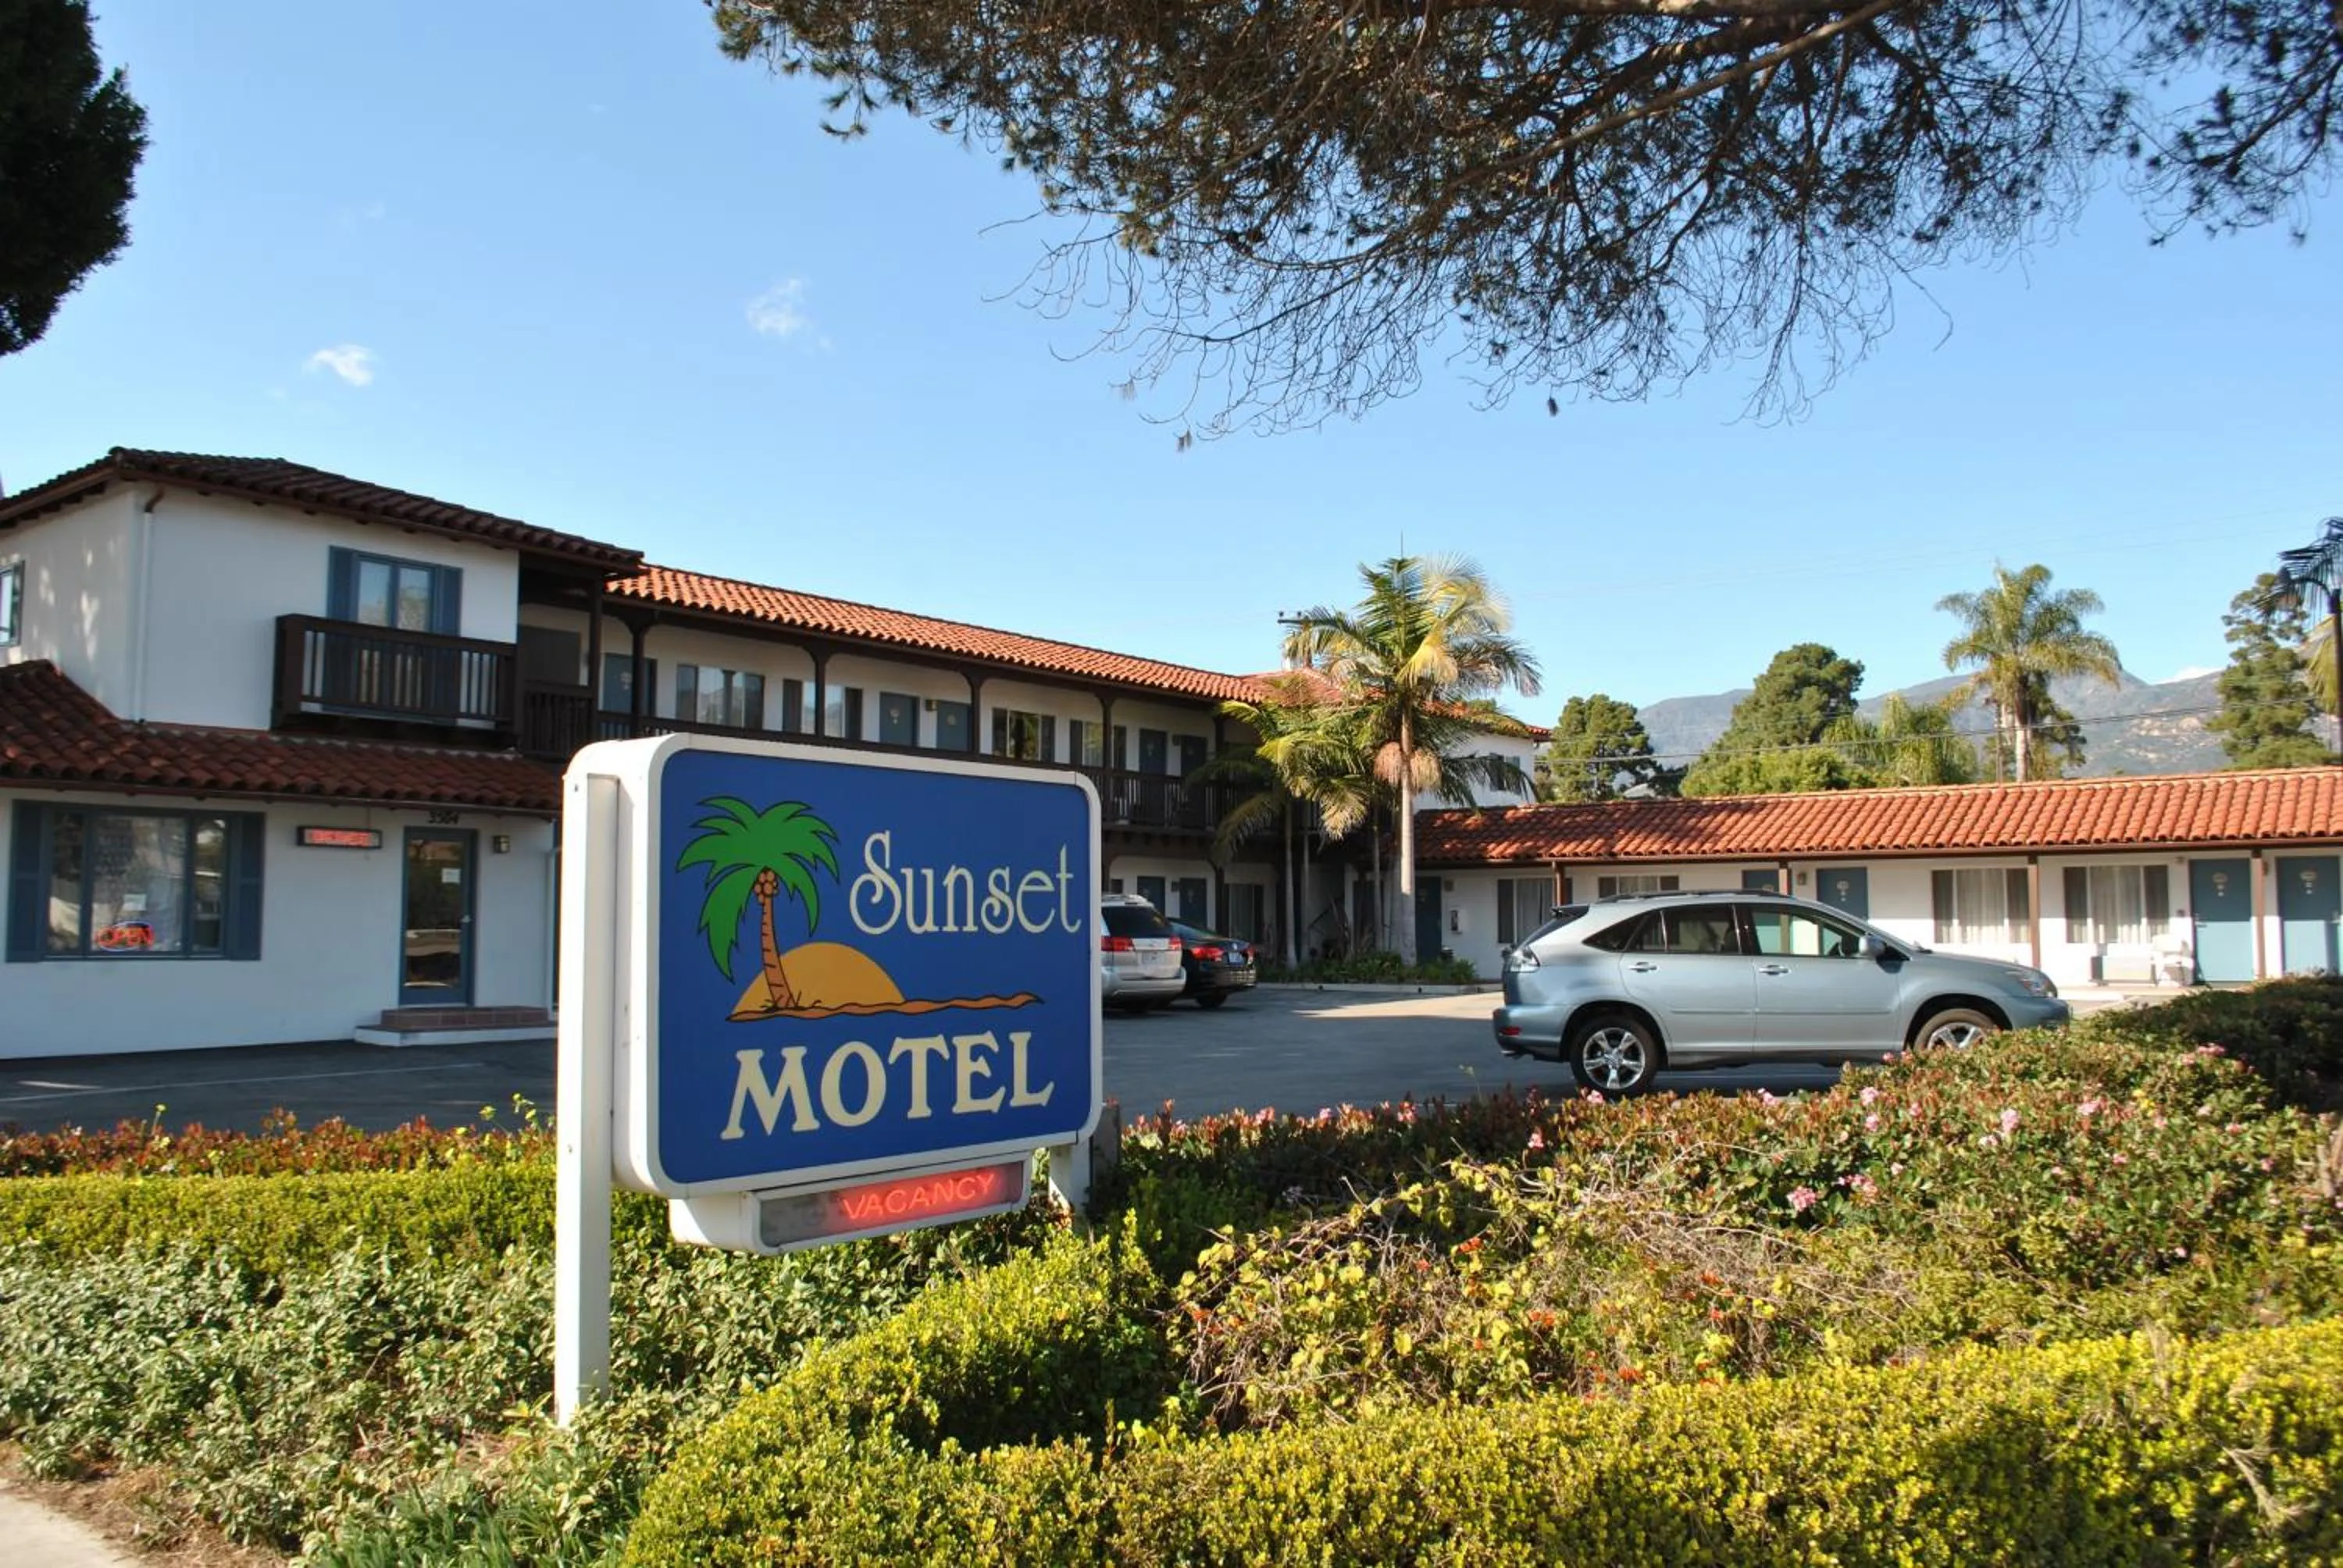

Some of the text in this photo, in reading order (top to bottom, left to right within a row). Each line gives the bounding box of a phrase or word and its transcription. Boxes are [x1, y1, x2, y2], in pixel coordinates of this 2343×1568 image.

[849, 830, 1082, 935] Sunset
[95, 925, 154, 949] OPEN
[719, 1031, 1055, 1140] MOTEL
[842, 1174, 996, 1221] VACANCY
